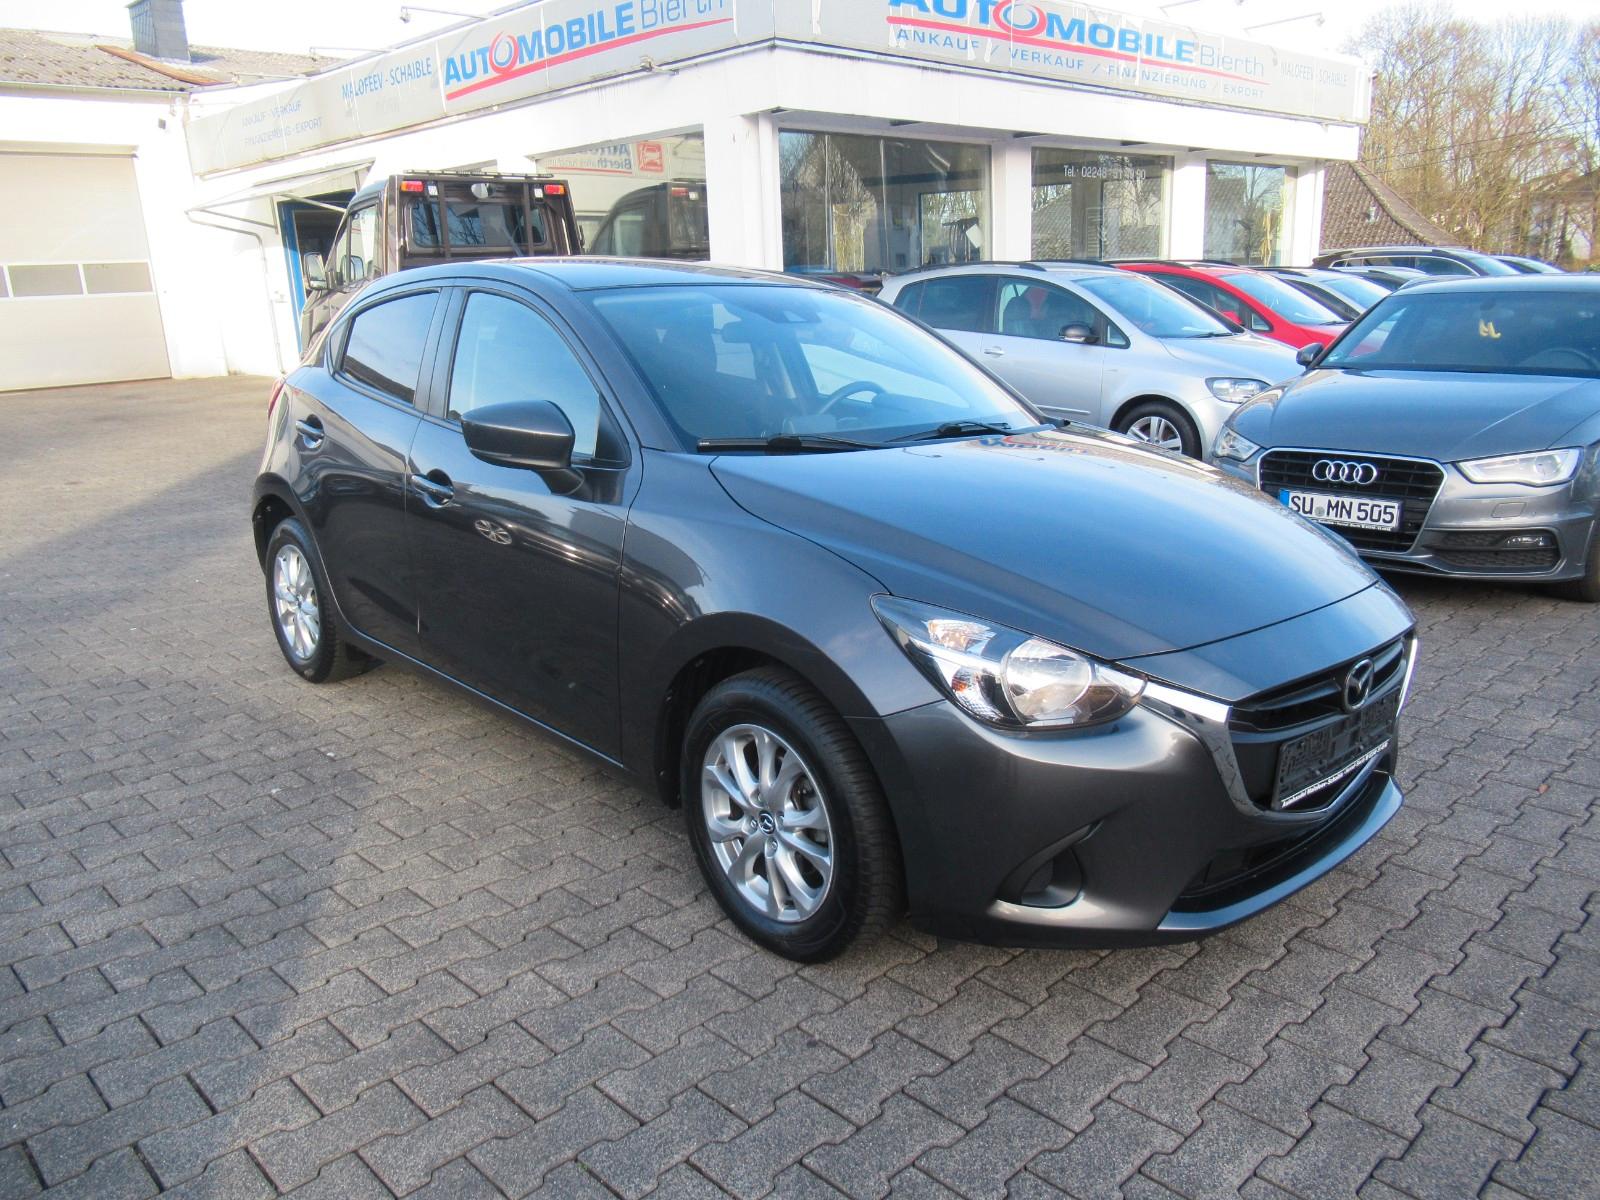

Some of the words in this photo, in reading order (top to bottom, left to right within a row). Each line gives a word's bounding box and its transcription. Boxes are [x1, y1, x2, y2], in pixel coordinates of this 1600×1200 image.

[444, 3, 636, 85] AUTOMOBILE
[1200, 44, 1265, 77] Bierth
[341, 71, 384, 99] MALOFEEV
[389, 56, 432, 86] SCHAIBLE
[1008, 46, 1085, 71] VERKAUF
[1223, 84, 1265, 99] EXPORT
[1290, 495, 1314, 515] SU
[1326, 498, 1353, 520] MN
[1357, 502, 1396, 524] 505
